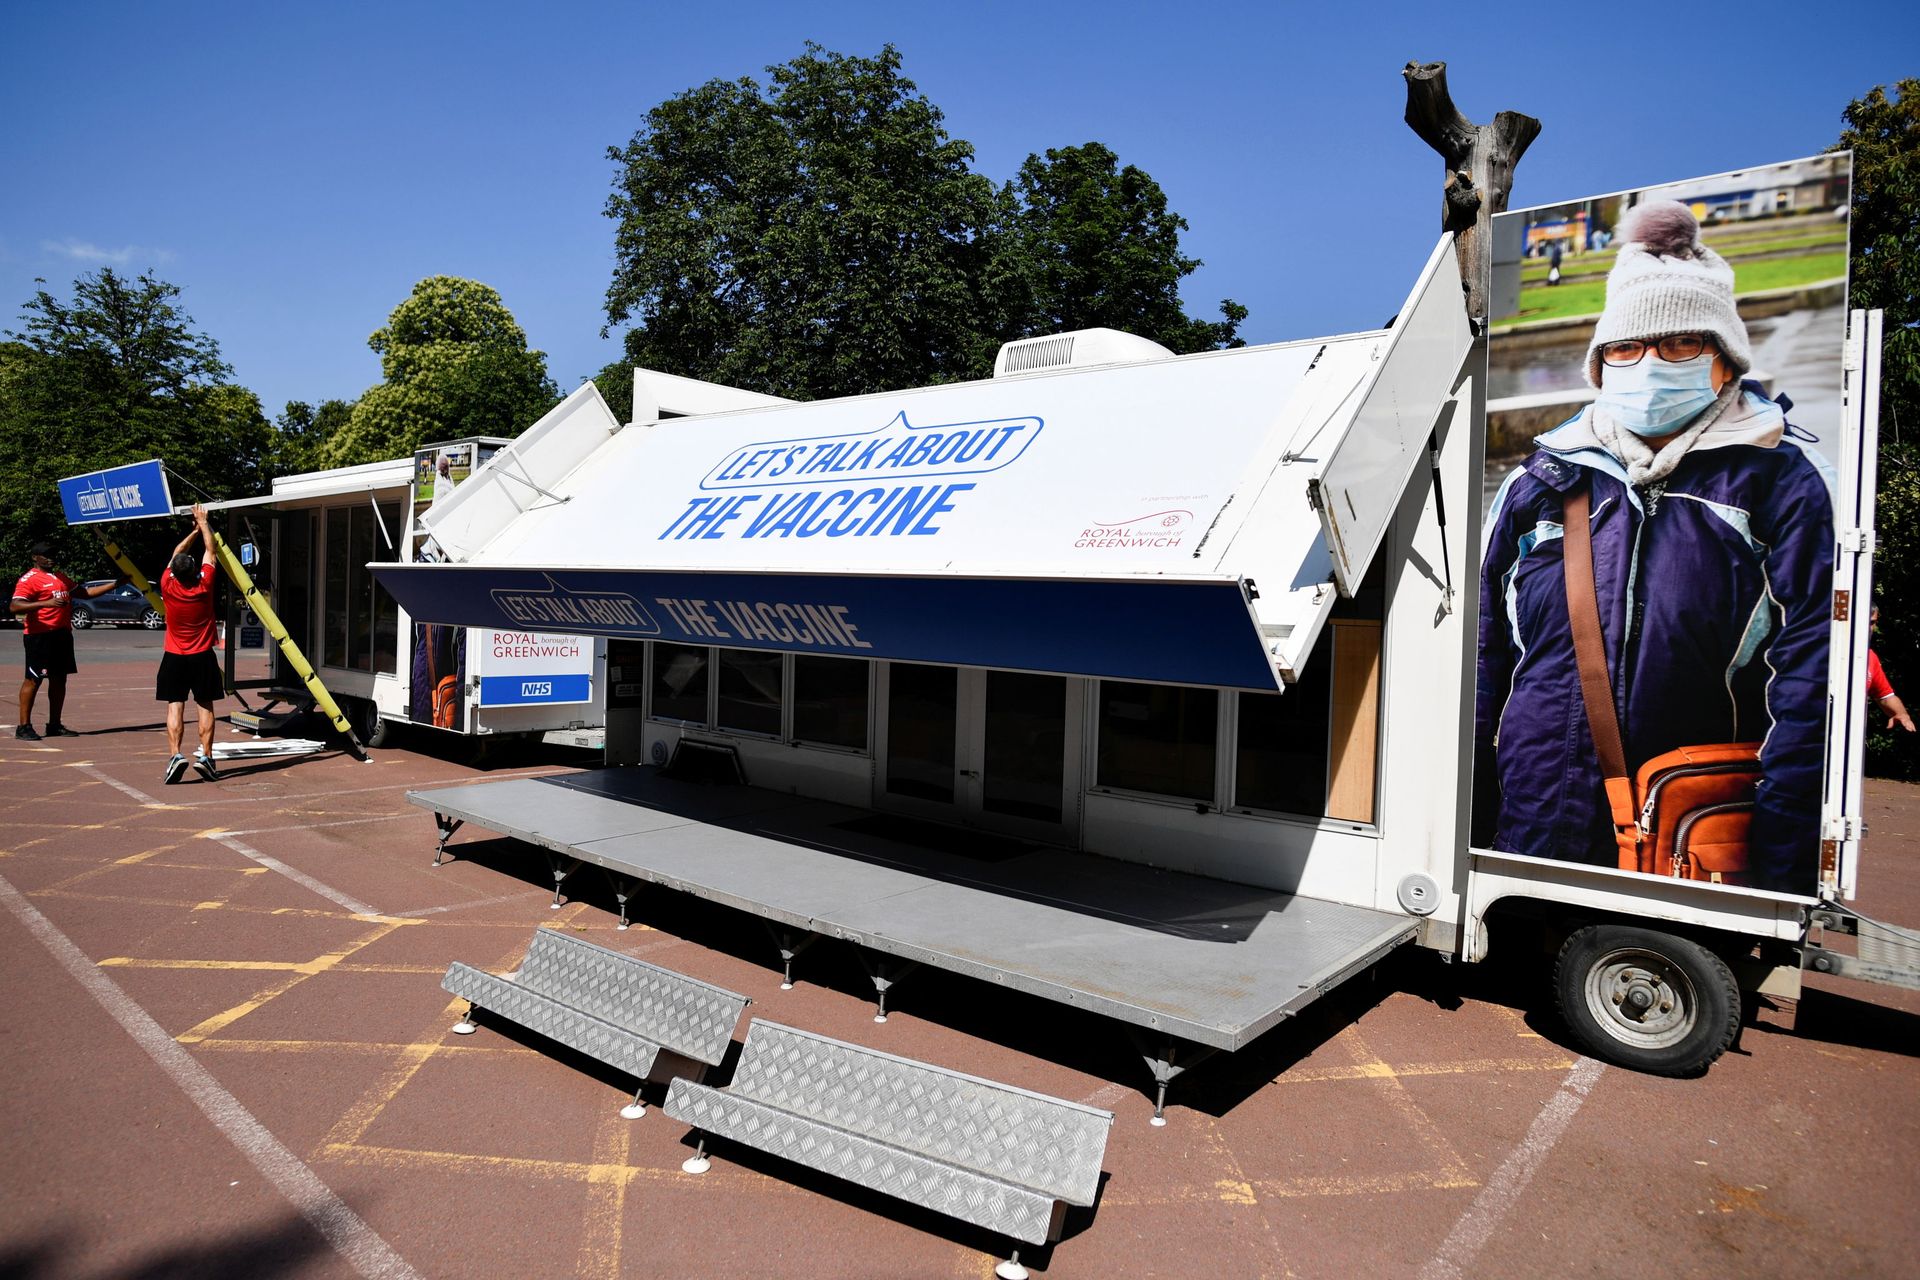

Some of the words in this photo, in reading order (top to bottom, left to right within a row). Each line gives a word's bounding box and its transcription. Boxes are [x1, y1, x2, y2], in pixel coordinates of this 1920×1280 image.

[716, 444, 806, 480] LET'S
[796, 437, 893, 474] TALK
[886, 425, 1026, 469] ABOUT
[109, 488, 122, 510] THE
[119, 484, 144, 509] VACCINE
[657, 494, 761, 540] THE
[741, 483, 977, 538] VACCINE
[1080, 528, 1131, 538] ROYAL
[1135, 530, 1172, 538] borough
[1074, 538, 1181, 548] GREENWICH
[499, 594, 550, 621] LET'S
[536, 597, 591, 623] TALK
[578, 598, 647, 626] ABOUT
[655, 597, 722, 639] THE
[713, 602, 873, 649] VACCINE
[493, 633, 538, 645] ROYAL
[541, 636, 569, 646] borough
[569, 636, 578, 644] of
[493, 646, 579, 658] GREENWICH
[523, 683, 550, 695] NHS
